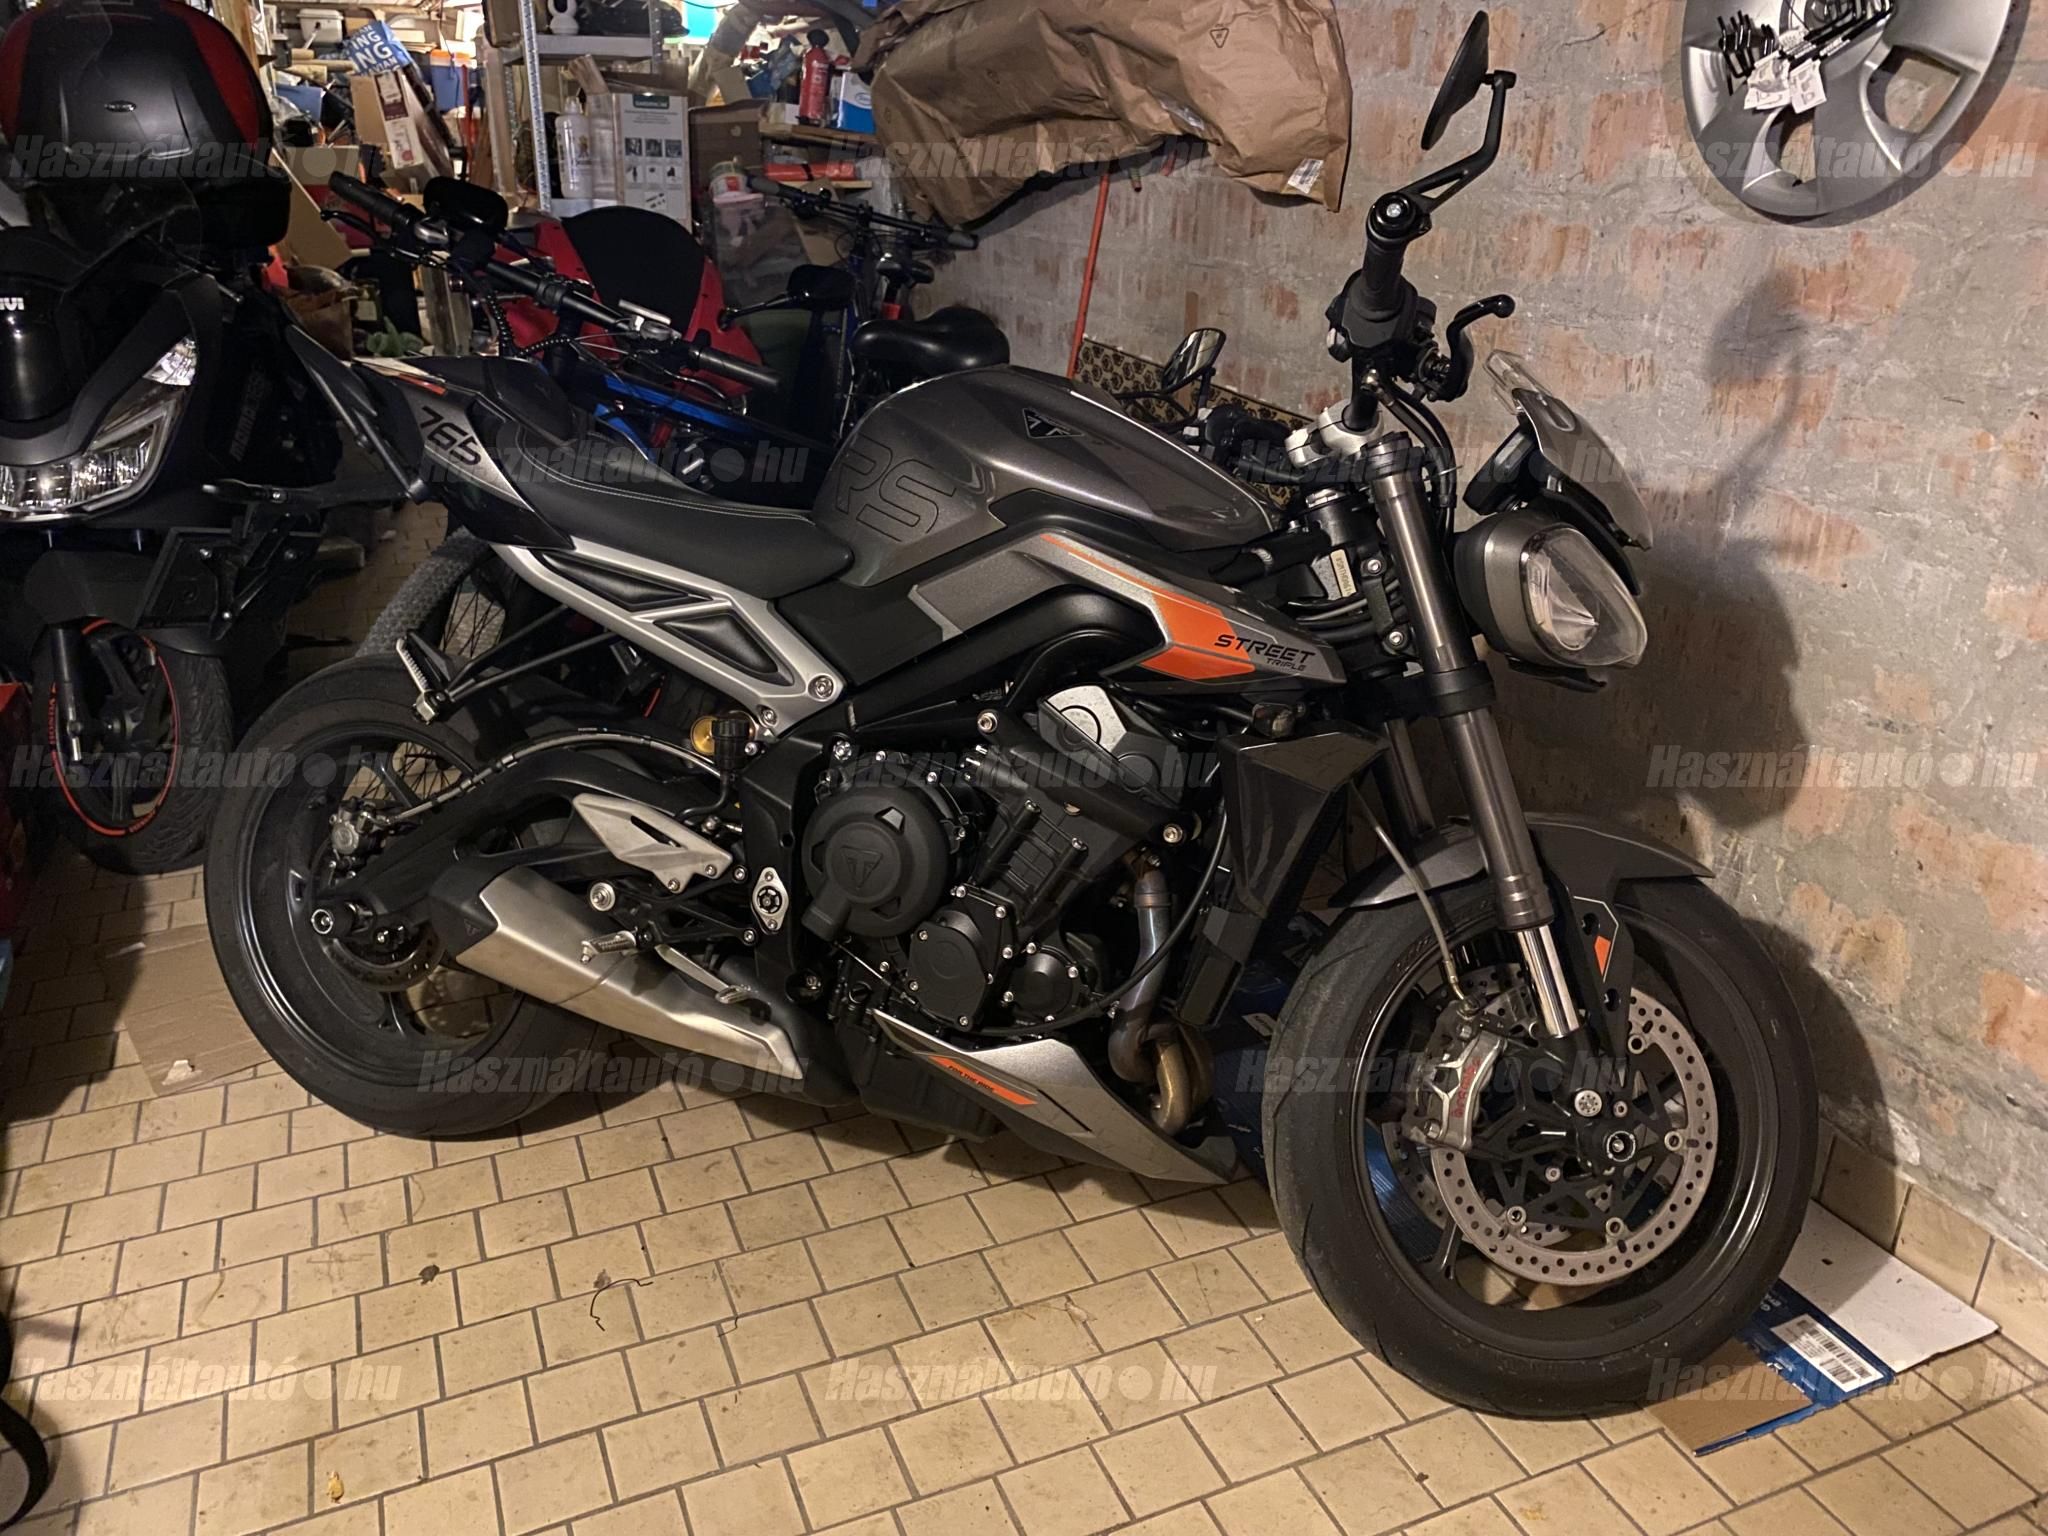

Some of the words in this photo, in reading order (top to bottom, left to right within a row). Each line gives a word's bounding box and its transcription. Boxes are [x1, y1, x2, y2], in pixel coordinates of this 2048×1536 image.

[420, 406, 481, 465] 765
[835, 433, 957, 542] RS
[1214, 634, 1315, 663] STREET
